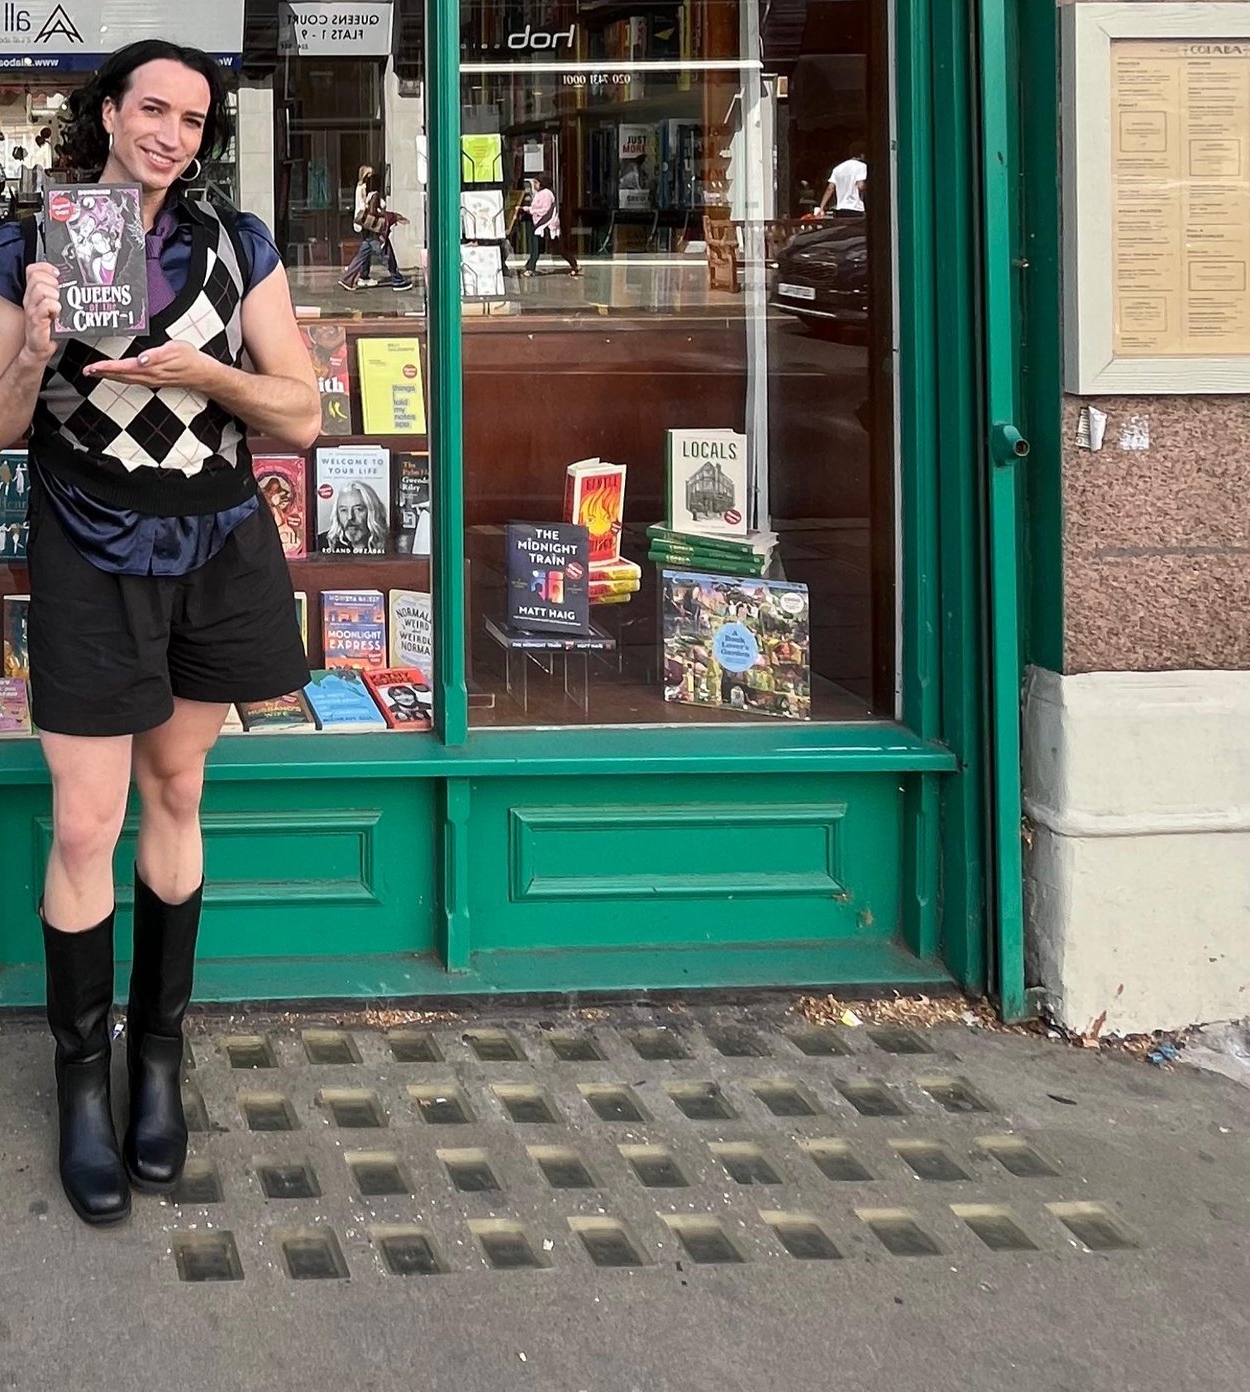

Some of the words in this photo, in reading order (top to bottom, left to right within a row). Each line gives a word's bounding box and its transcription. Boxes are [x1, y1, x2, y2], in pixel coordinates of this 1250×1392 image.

[627, 135, 647, 145] JUST
[67, 285, 132, 310] QUEENS
[317, 376, 345, 393] ith
[682, 441, 738, 460] LOCALS
[535, 528, 560, 541] THE
[352, 547, 386, 555] ORZABAL
[395, 607, 431, 624] NORMAL
[519, 606, 546, 618] MATT
[549, 609, 576, 620] HAIG
[404, 618, 430, 631] WEIRD
[328, 630, 382, 640] MOONLIGHT
[399, 632, 431, 646] WEIRDL
[329, 640, 381, 651] EXPRESS
[401, 641, 431, 656] NORMA
